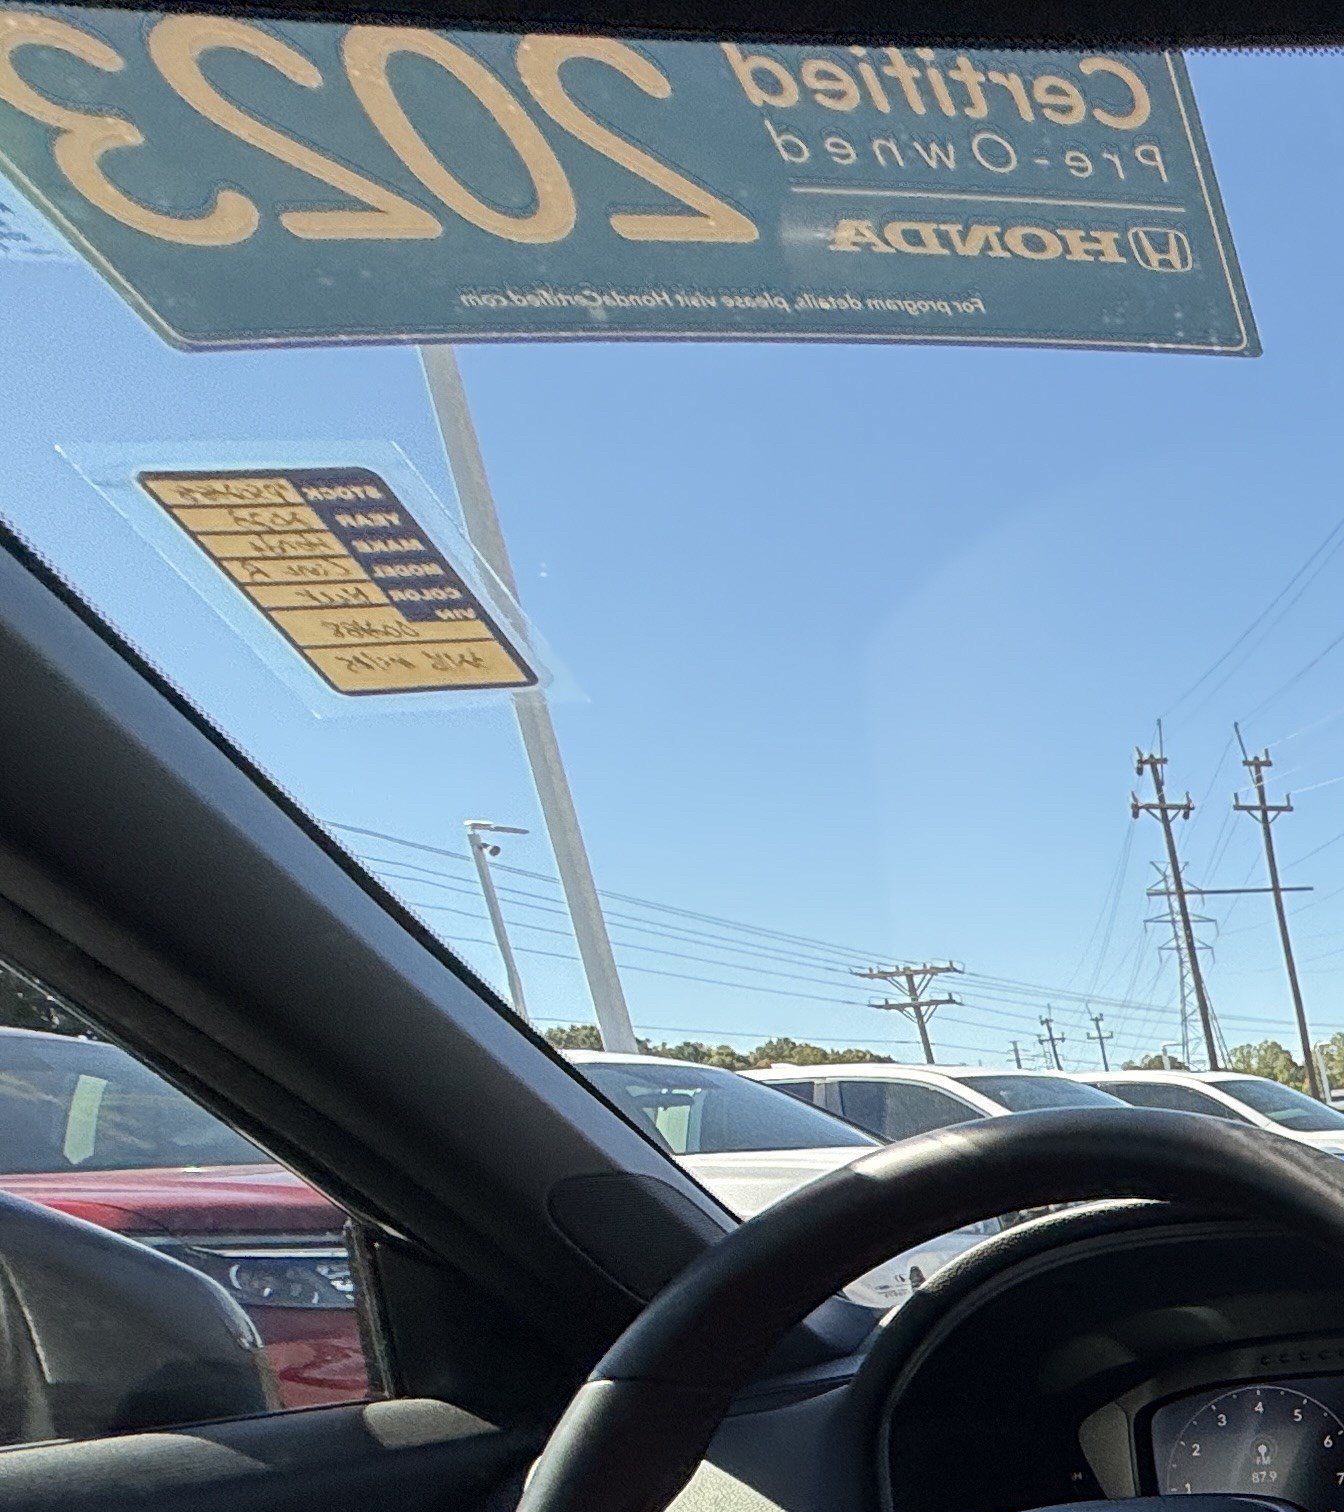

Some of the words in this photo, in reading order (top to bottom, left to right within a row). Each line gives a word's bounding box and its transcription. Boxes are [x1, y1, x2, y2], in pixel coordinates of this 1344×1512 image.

[1254, 1401, 1264, 1413] 4
[1217, 1413, 1227, 1426] 3
[1293, 1409, 1303, 1422] 5
[1323, 1435, 1333, 1448] 6
[1191, 1443, 1201, 1456] 2
